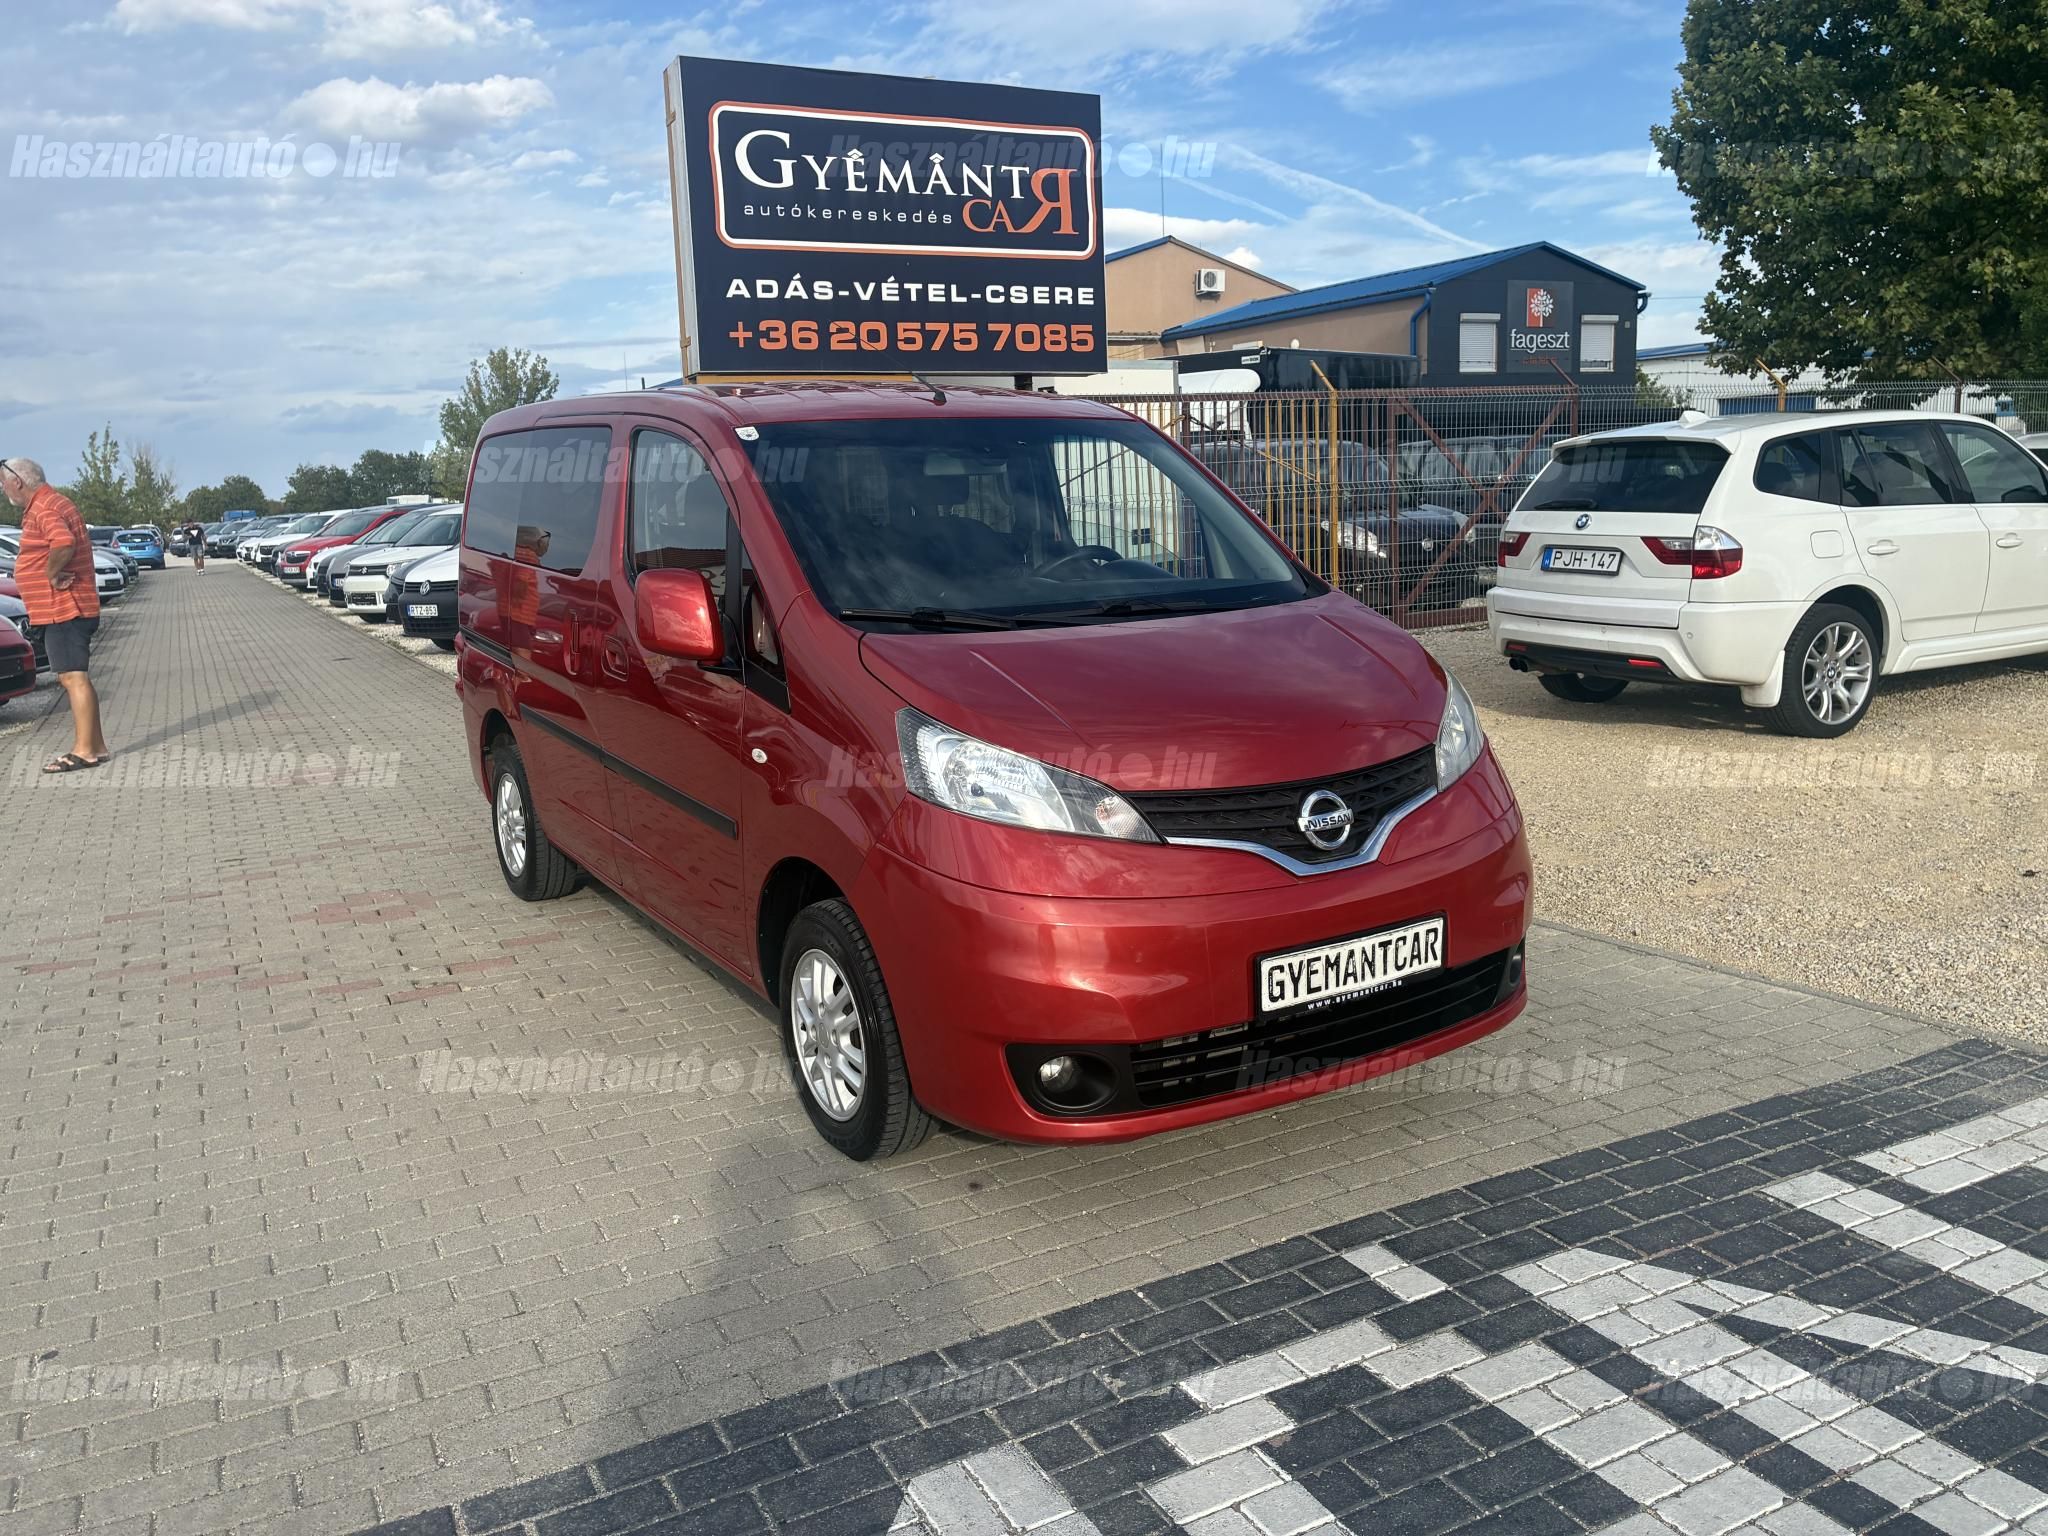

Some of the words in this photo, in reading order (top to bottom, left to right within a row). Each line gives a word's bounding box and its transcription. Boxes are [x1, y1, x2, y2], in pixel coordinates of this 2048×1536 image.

[743, 202, 953, 225] autókereskedés
[725, 272, 1096, 306] ADÁS-VÉTEL-CSERE
[728, 319, 819, 350] +36
[829, 320, 889, 351] 20
[896, 321, 979, 352] 575
[987, 322, 1096, 352] 7085
[1510, 328, 1570, 353] fageszt
[1552, 550, 1617, 570] PJH-147
[1307, 812, 1351, 829] NISSAN
[1267, 927, 1439, 1003] GYEMANTCAR
[1307, 980, 1403, 1010] www.gyemantcar.hu
